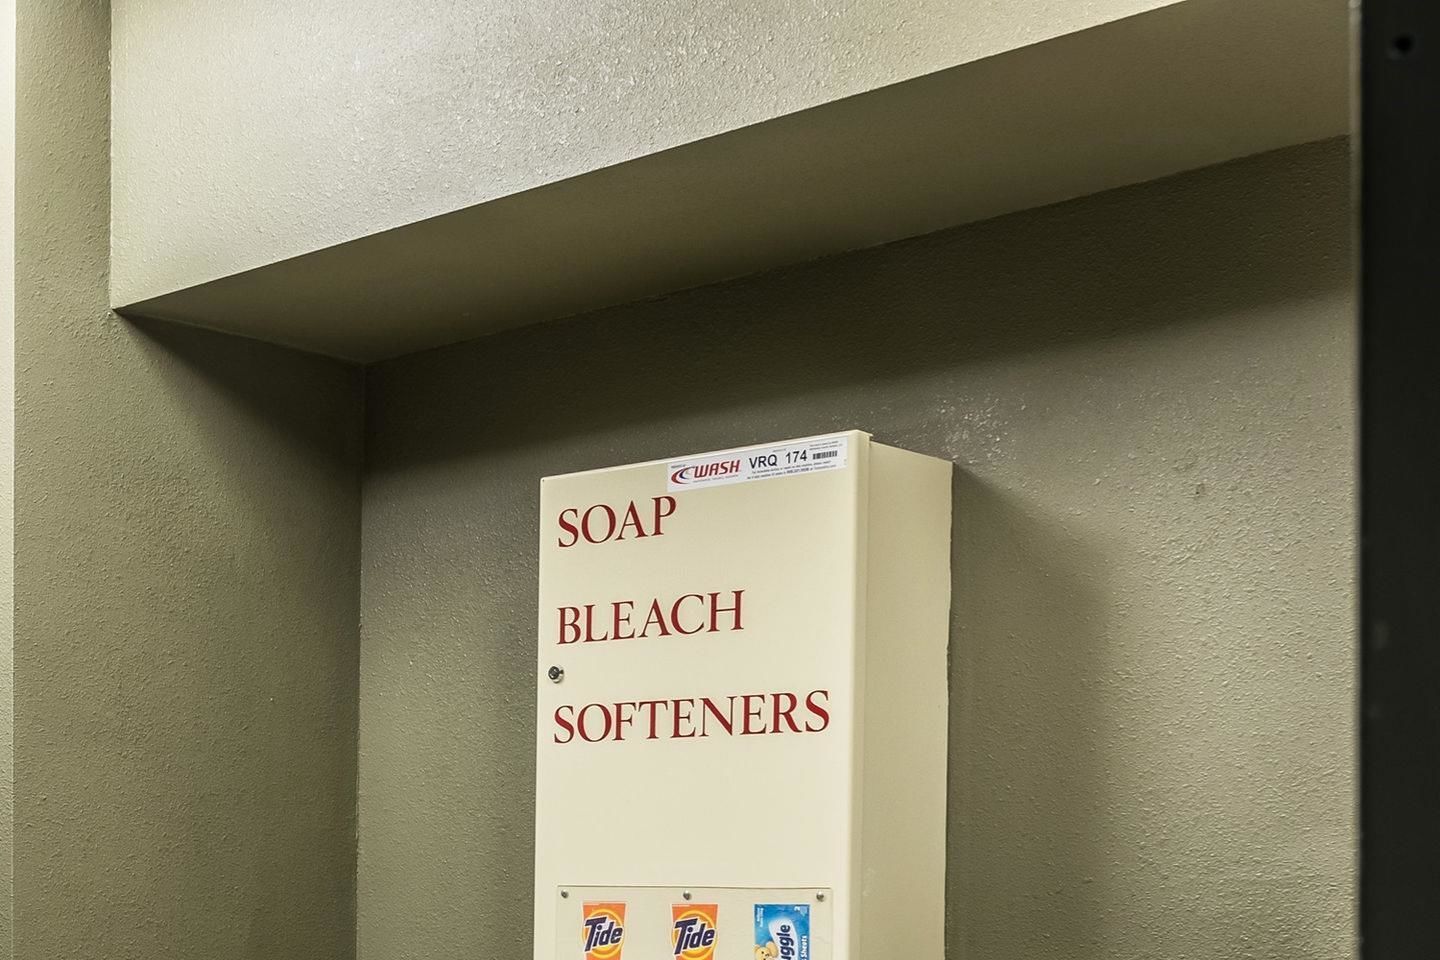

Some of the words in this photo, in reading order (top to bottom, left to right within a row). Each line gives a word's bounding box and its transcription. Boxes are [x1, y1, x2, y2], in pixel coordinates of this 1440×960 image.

[693, 460, 741, 478] WASH
[749, 454, 778, 469] VRQ
[785, 450, 807, 464] 174
[557, 495, 677, 548] SOAP
[556, 590, 745, 645] BLEACH
[554, 690, 830, 744] SOFTENERS
[585, 917, 623, 952] Tide
[674, 918, 715, 955] Tide
